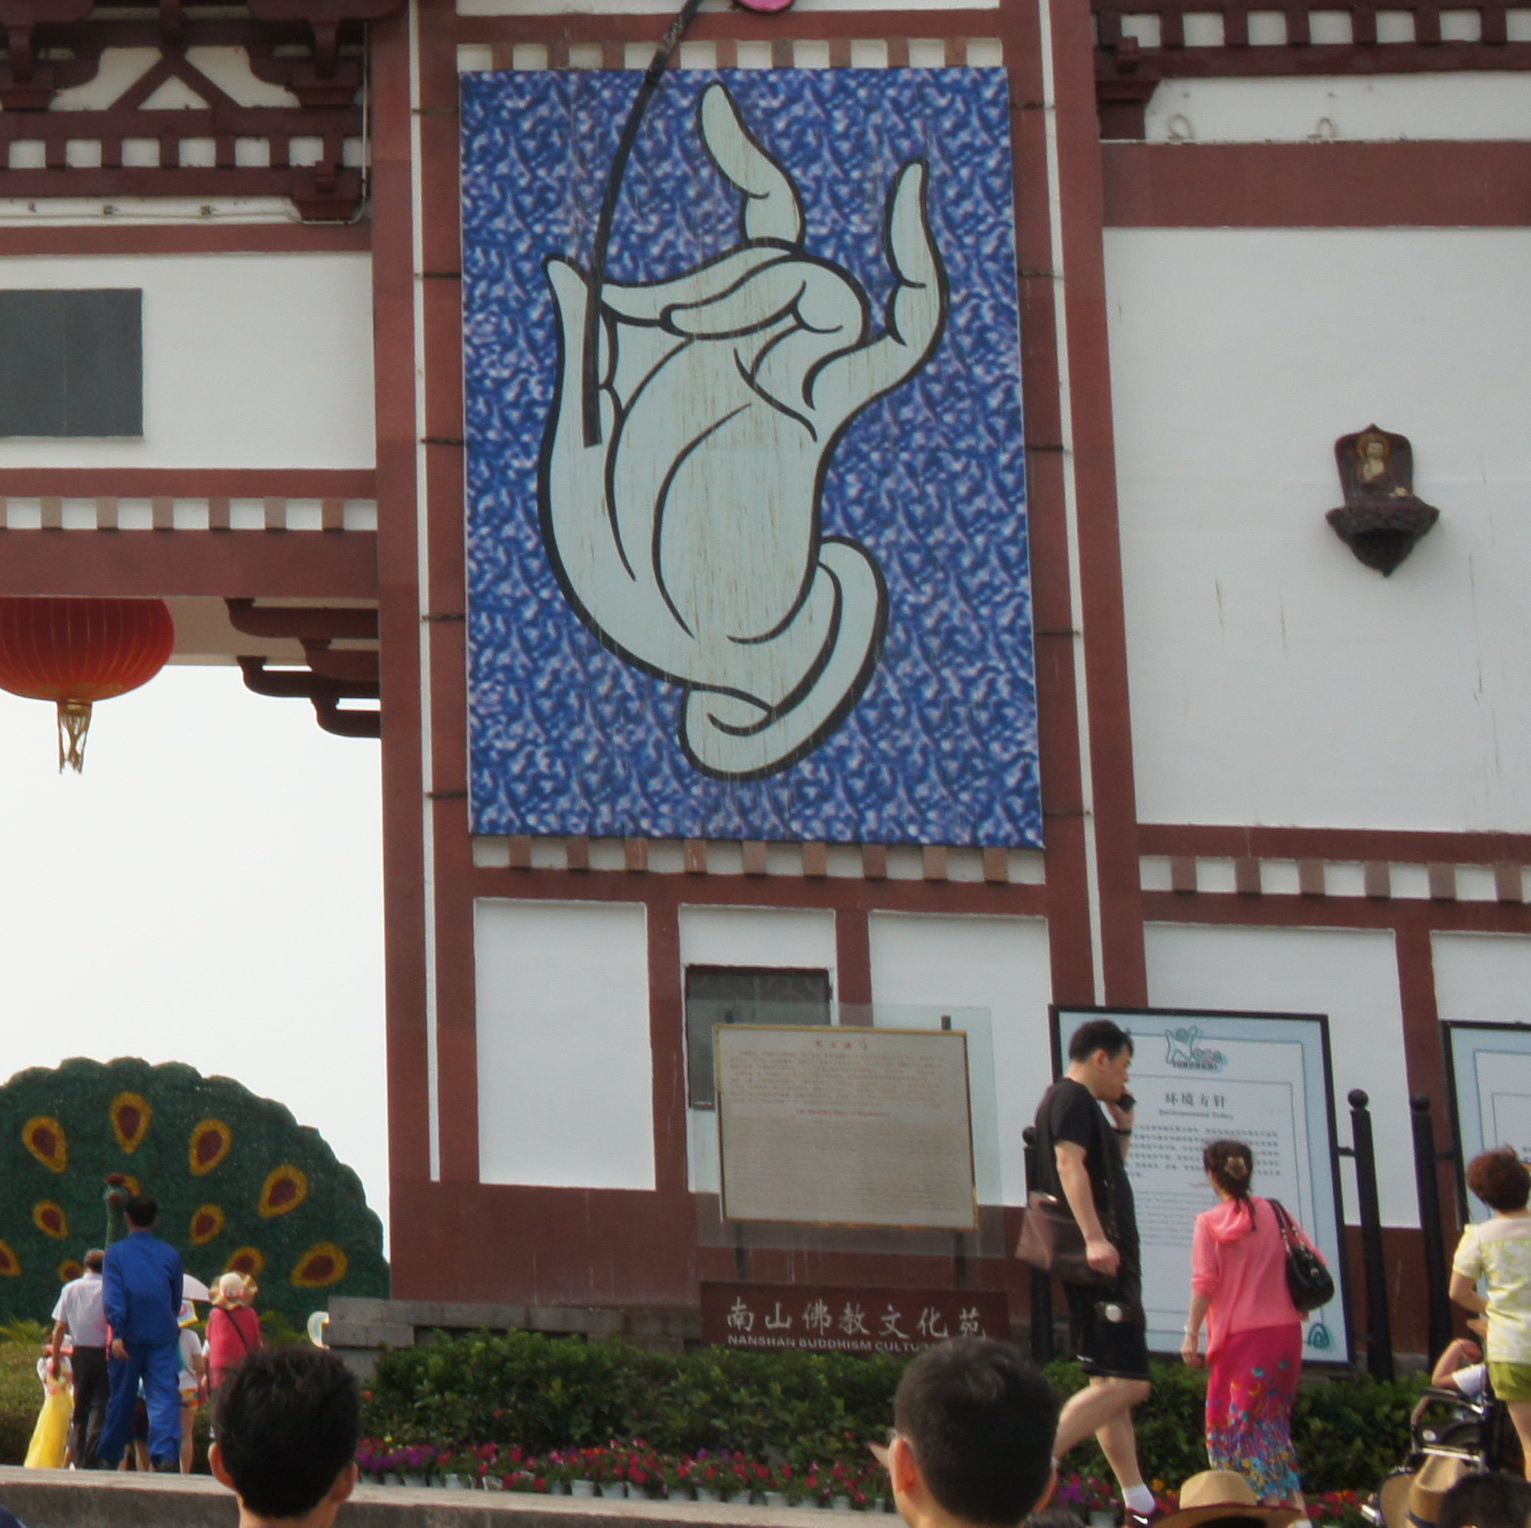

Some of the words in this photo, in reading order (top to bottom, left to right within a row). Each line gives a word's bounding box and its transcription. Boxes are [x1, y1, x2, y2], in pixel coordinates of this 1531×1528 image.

[726, 1296, 987, 1342] 南山佛教文化苑
[727, 1336, 796, 1348] NANSHAN
[799, 1337, 872, 1351] BUDDHISM
